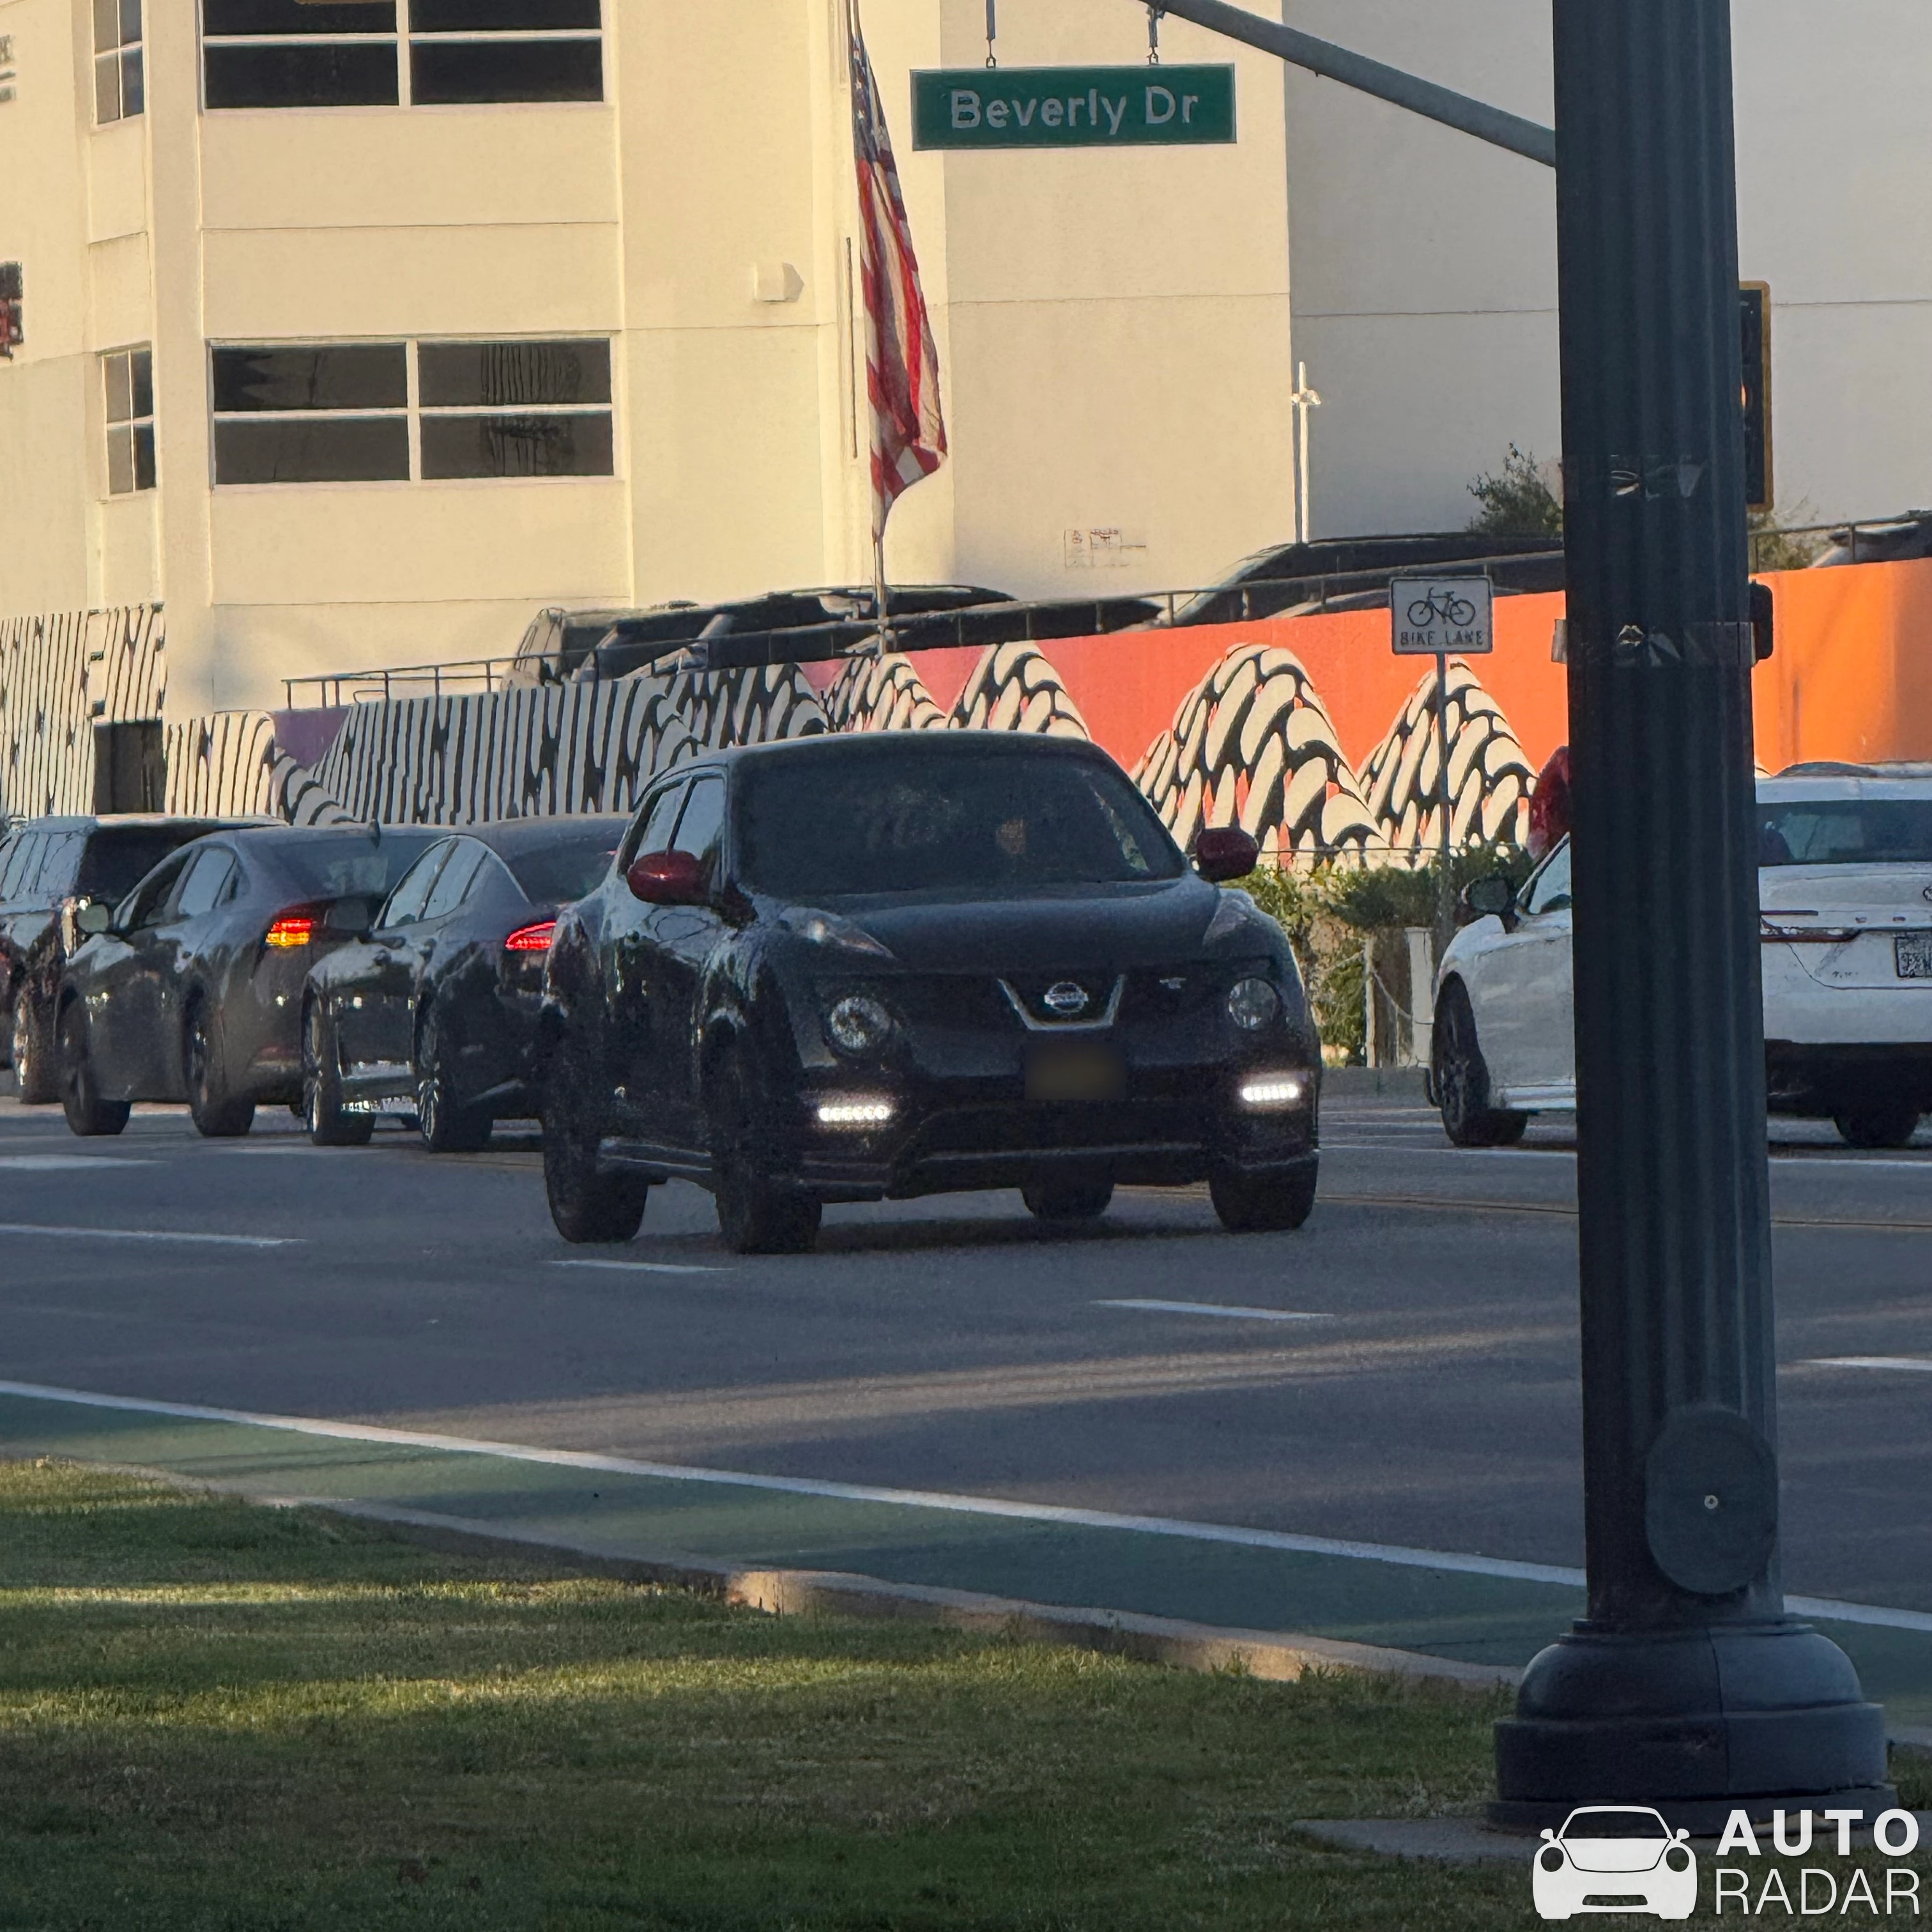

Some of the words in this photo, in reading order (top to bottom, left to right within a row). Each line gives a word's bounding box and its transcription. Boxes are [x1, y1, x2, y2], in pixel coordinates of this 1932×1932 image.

[951, 88, 1126, 135] Beverly
[1146, 86, 1199, 125] Dr
[1400, 631, 1436, 647] BIKE
[1445, 631, 1483, 646] LANE
